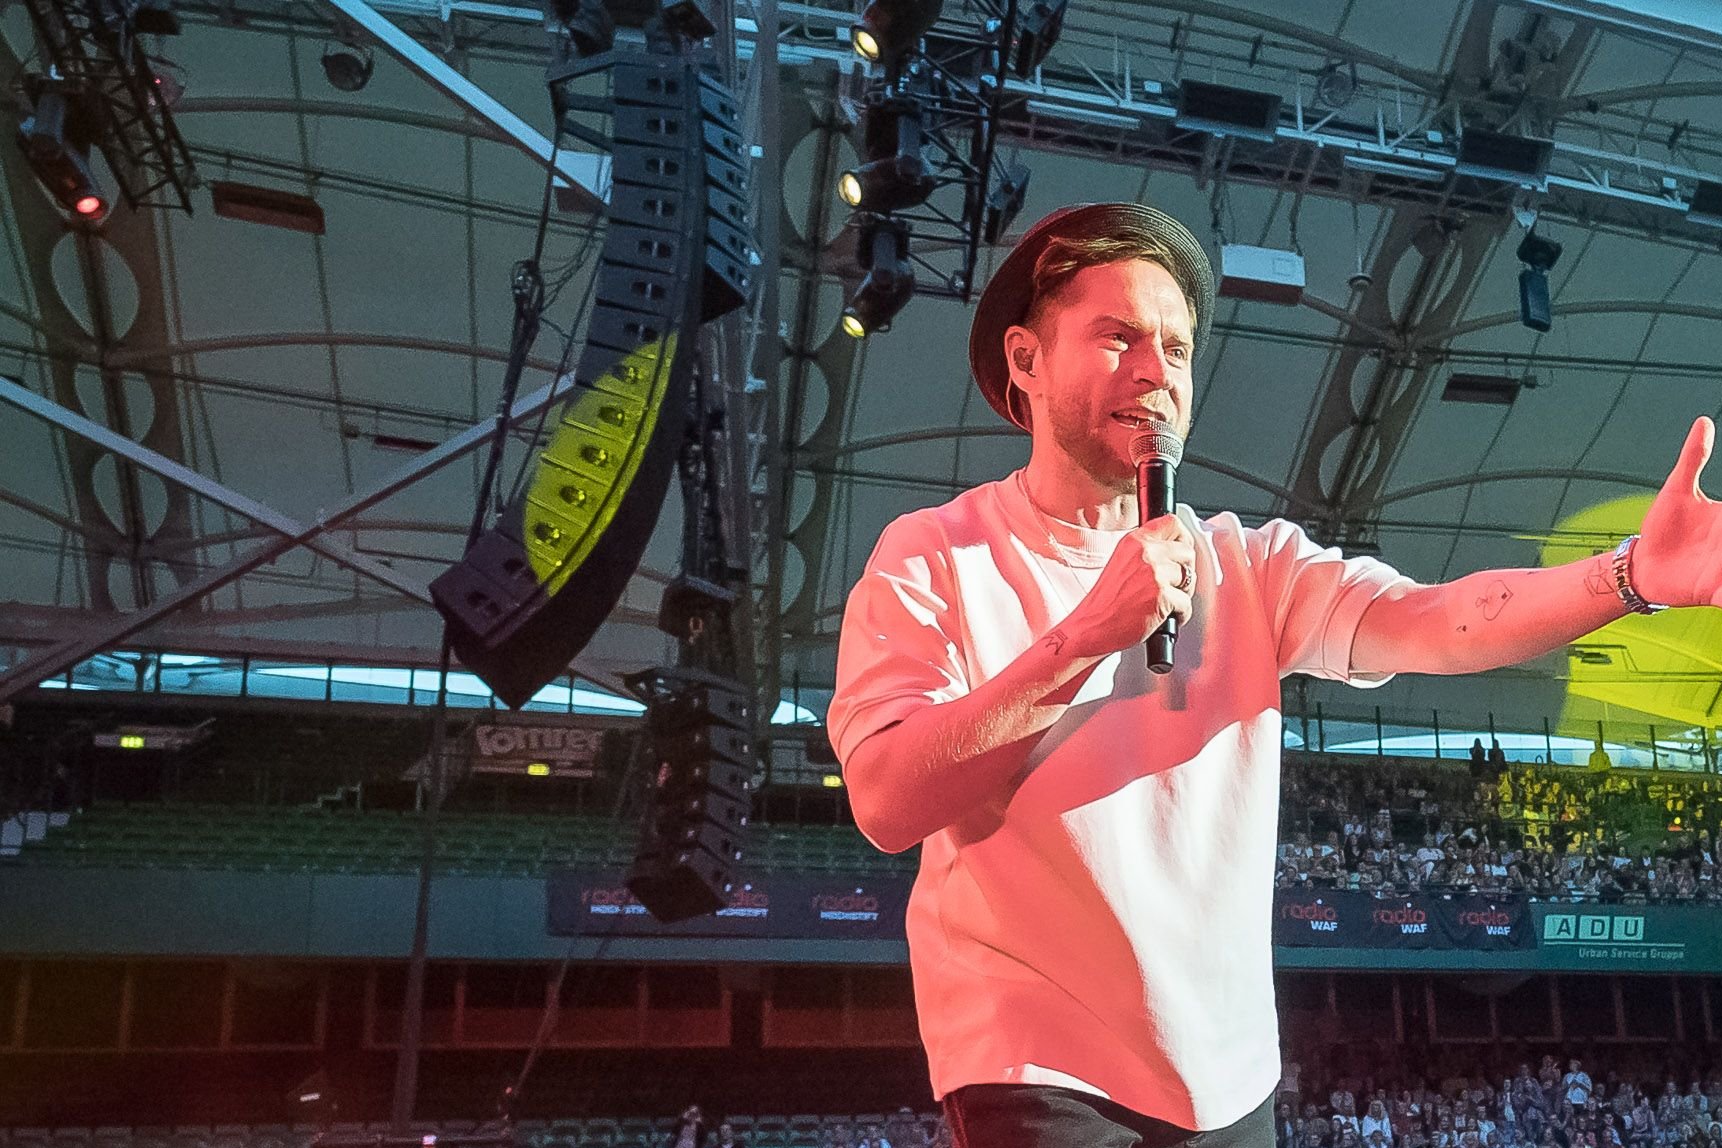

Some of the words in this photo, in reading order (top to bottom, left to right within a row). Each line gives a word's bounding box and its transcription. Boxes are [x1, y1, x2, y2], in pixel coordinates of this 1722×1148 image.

[1311, 921, 1338, 931] WAF
[1401, 924, 1427, 933] WAF
[1486, 926, 1511, 935] WAF
[1579, 948, 1608, 957] Urban
